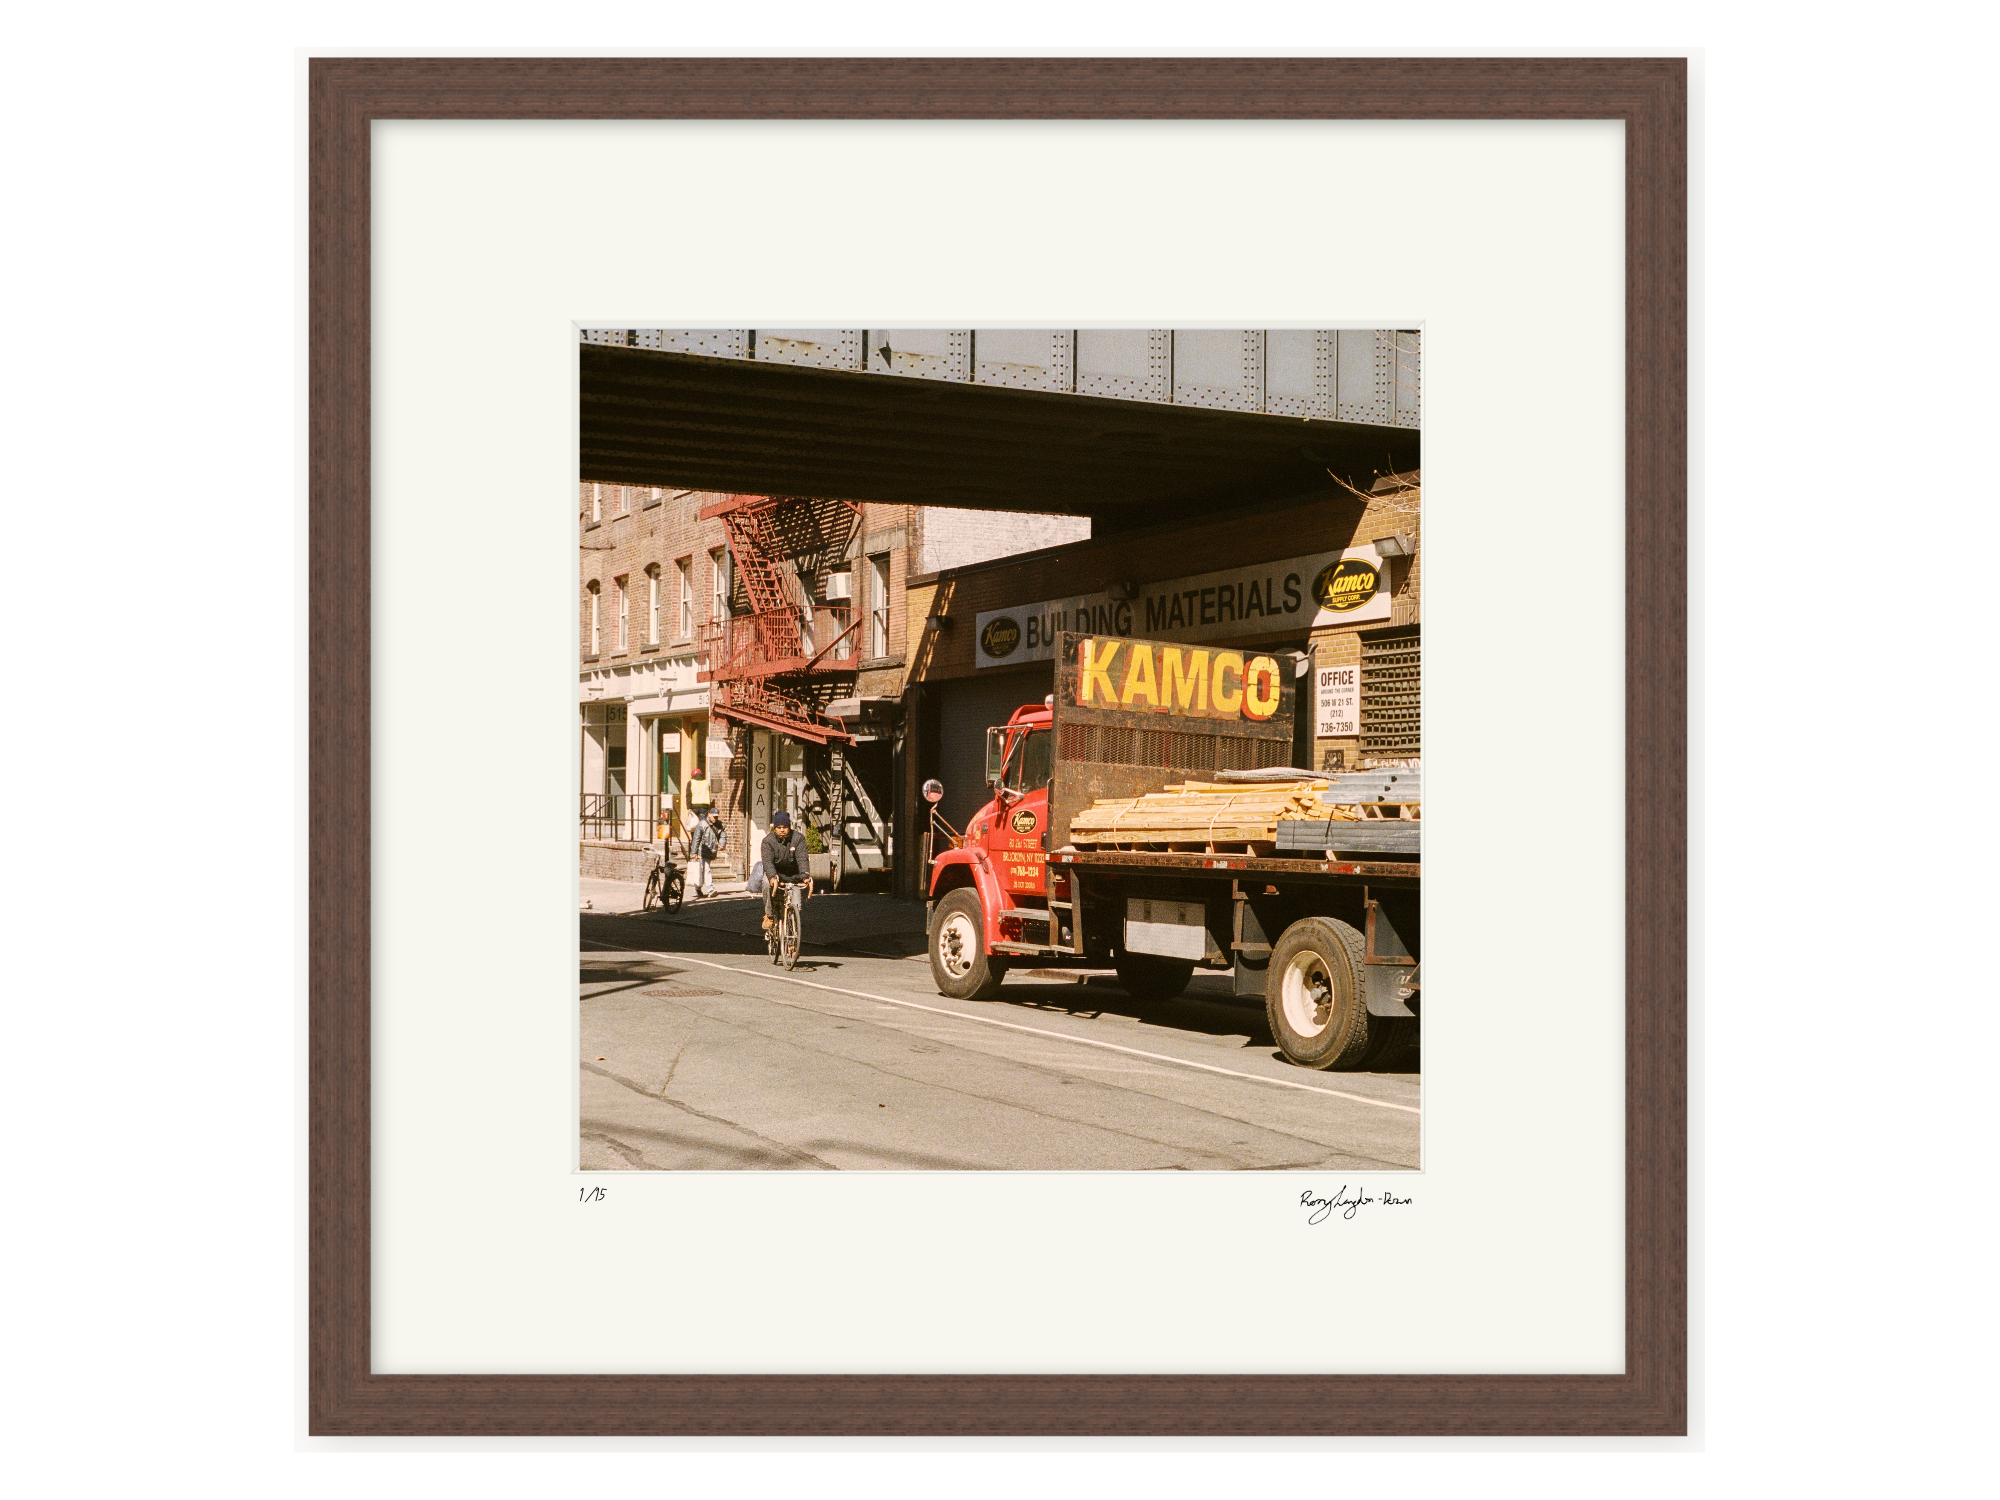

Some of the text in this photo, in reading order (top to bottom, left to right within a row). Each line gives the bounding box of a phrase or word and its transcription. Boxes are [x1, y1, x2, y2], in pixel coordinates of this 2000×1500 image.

[1319, 564, 1375, 597] Kamco
[1146, 572, 1302, 632] MATERIALS
[984, 621, 1017, 647] Kamco
[1078, 638, 1281, 717] KAMCO
[1321, 670, 1354, 686] OFFICE
[699, 694, 709, 705] 513
[1321, 699, 1331, 707] 506
[1345, 698, 1354, 706] ST.
[610, 707, 627, 720] 515
[1330, 709, 1344, 719] (212)
[1321, 721, 1354, 732] 736-7350
[756, 746, 766, 806] YOGA
[1013, 811, 1035, 826] Kamco
[1026, 853, 1034, 863] NY
